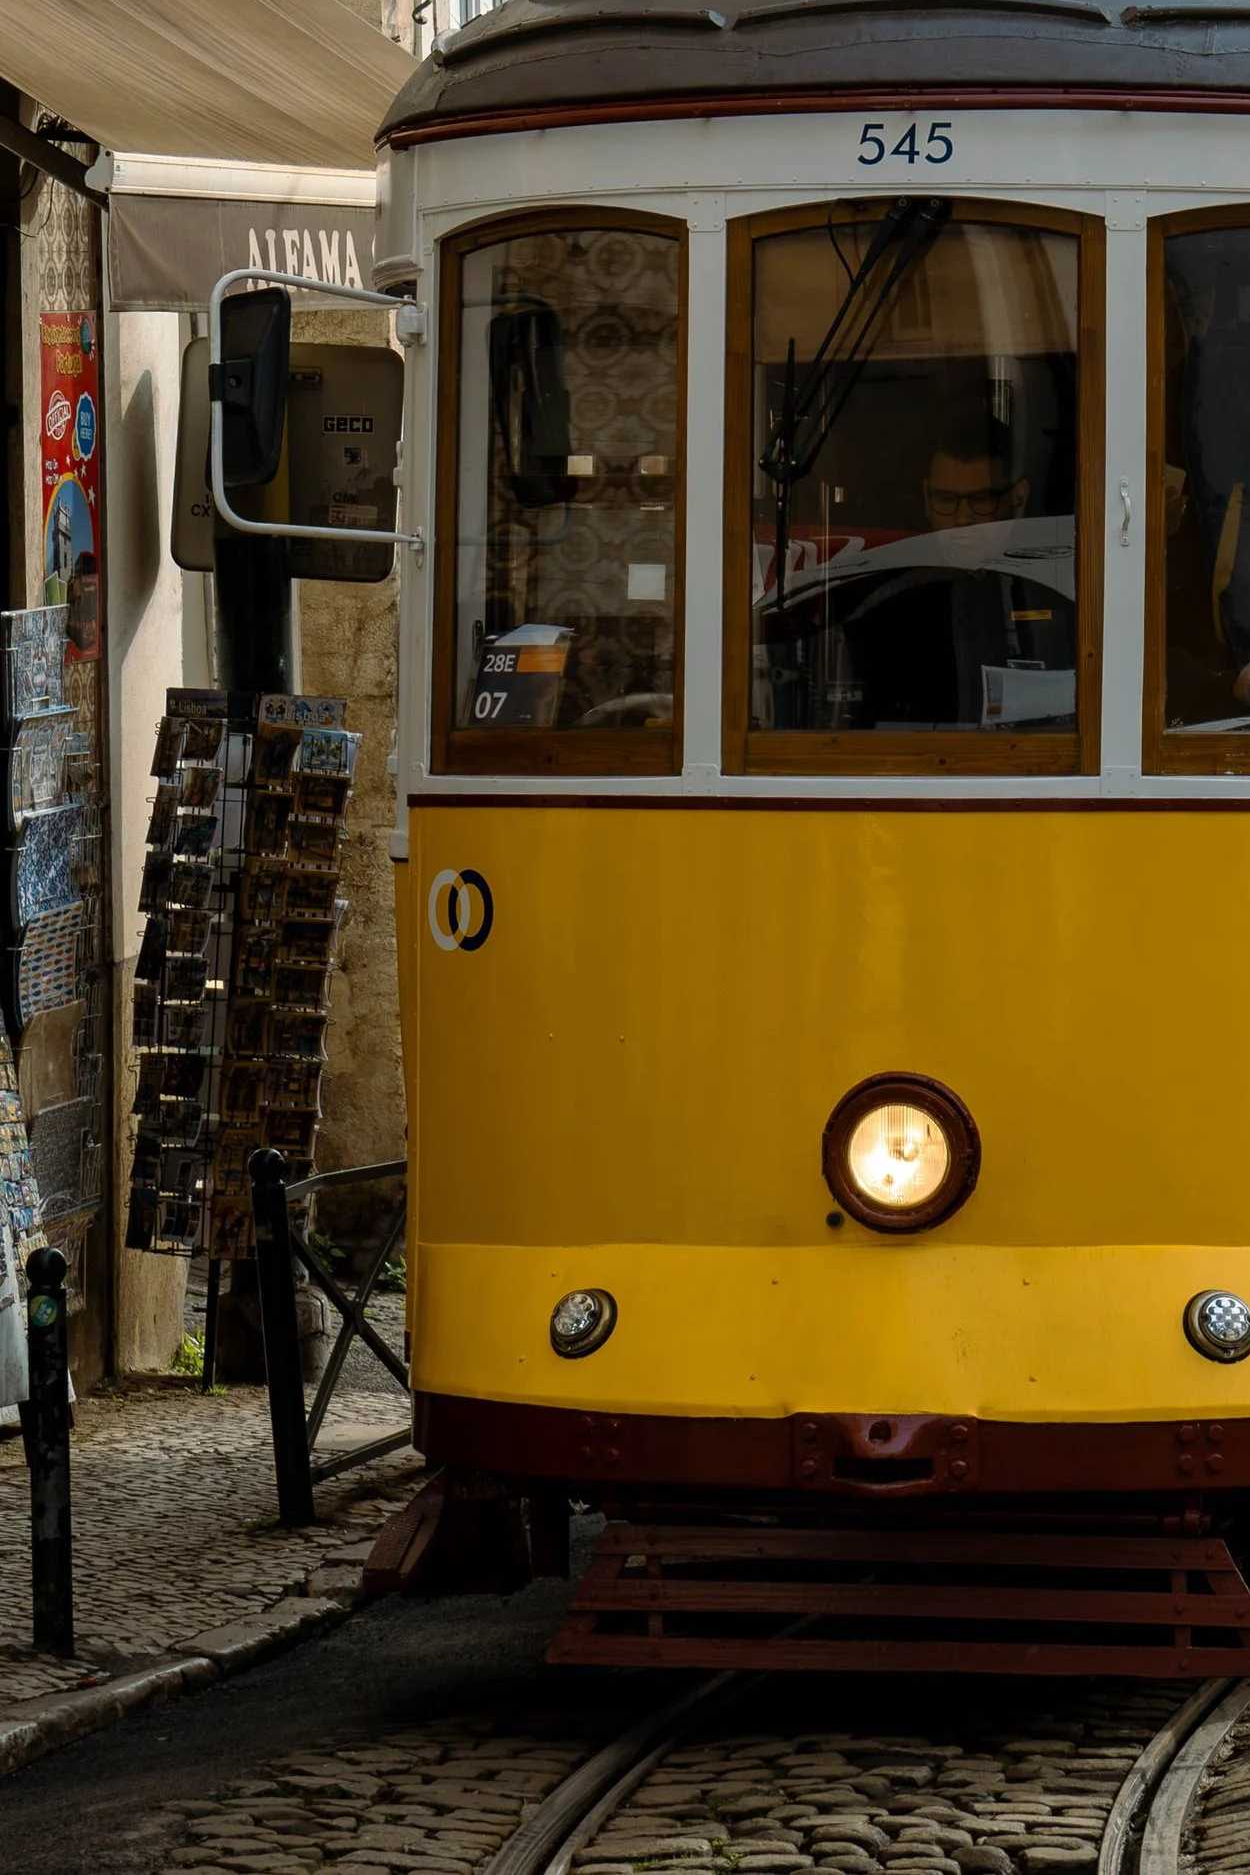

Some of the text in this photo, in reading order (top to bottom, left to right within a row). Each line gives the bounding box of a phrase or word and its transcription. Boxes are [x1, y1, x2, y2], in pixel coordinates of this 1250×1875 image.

[857, 122, 953, 165] 545
[246, 228, 364, 293] ALFAMA
[80, 411, 91, 426] BUY
[483, 654, 516, 672] 28E
[178, 701, 207, 715] Lisboa
[474, 691, 508, 719] 07
[284, 708, 326, 724] Lisboa
